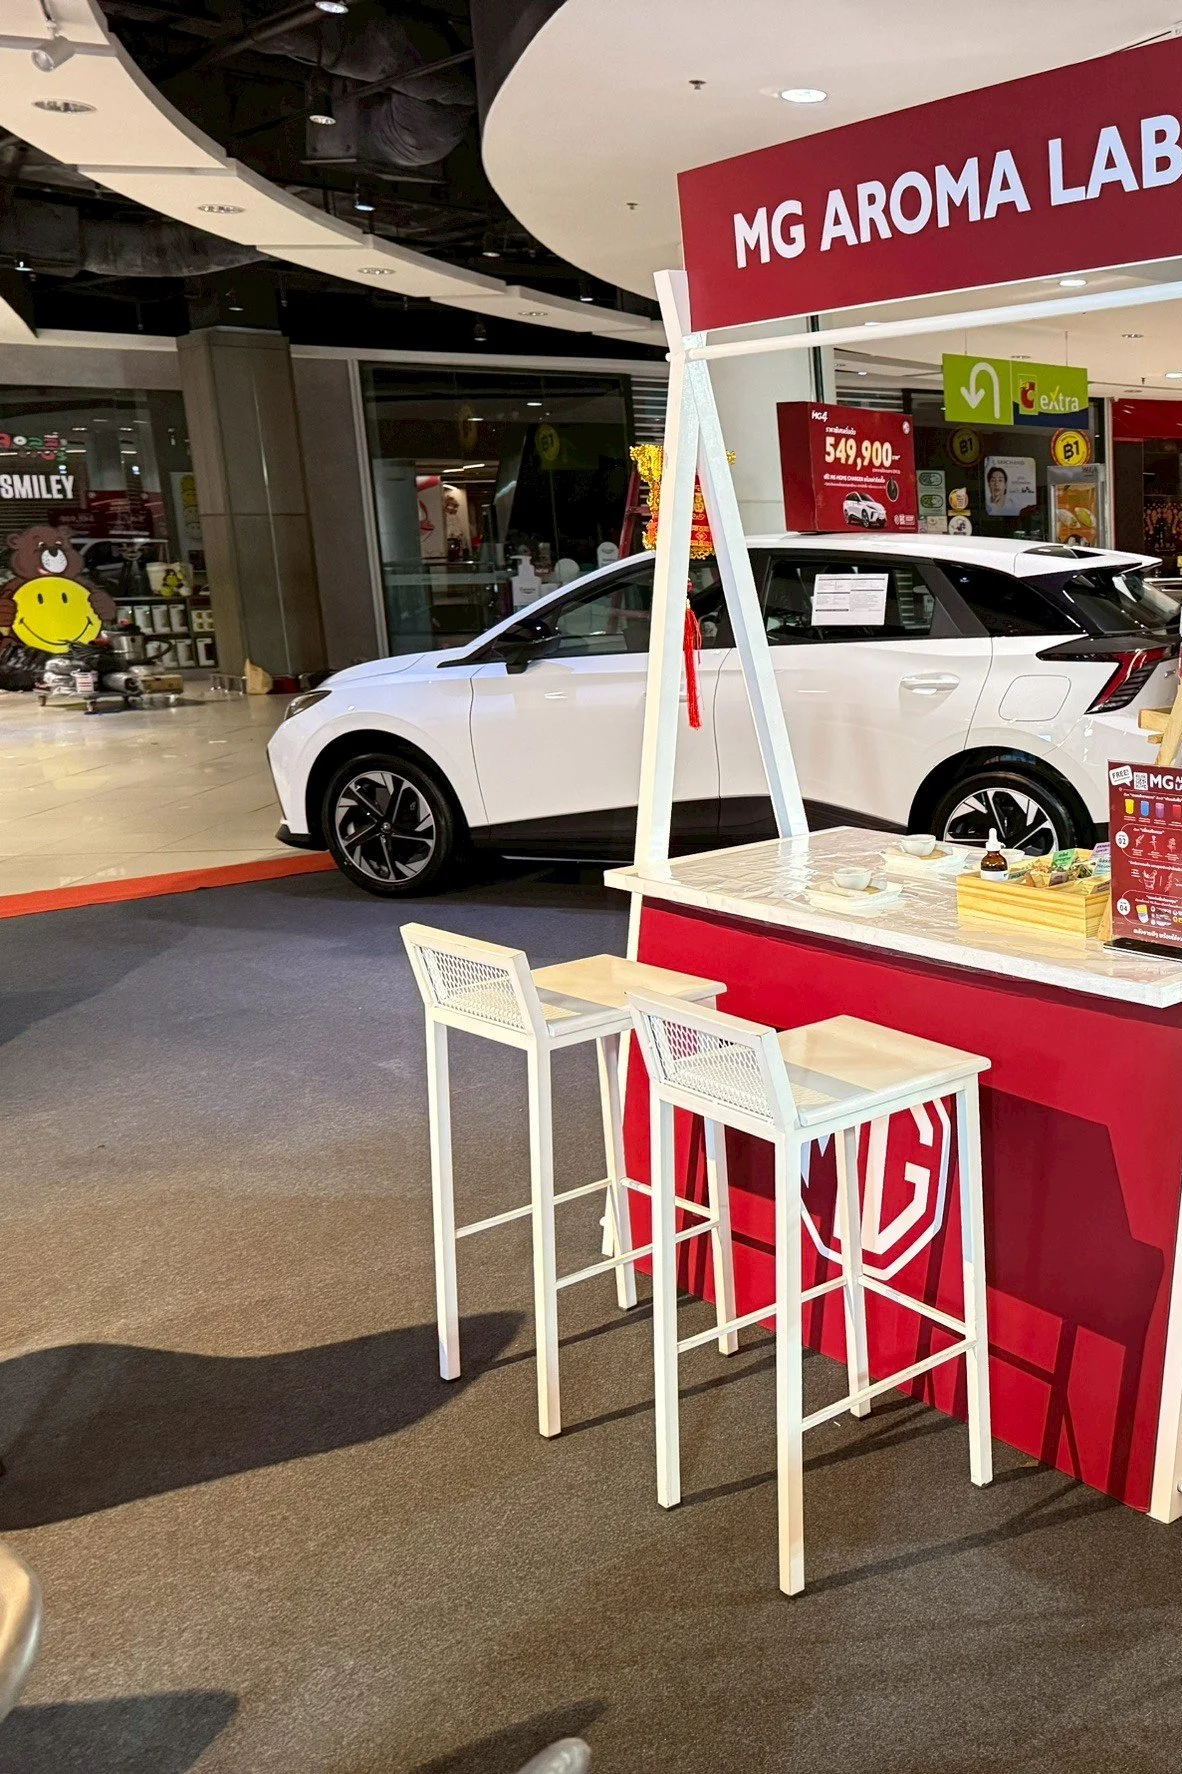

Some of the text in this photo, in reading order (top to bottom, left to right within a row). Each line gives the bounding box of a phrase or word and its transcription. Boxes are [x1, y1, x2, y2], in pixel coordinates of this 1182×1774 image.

[733, 199, 805, 268] MG
[820, 150, 1031, 252] AROMA
[824, 436, 893, 471] 549,900
[0, 474, 75, 499] SMILEY
[1111, 769, 1129, 779] FREE!
[1150, 774, 1174, 790] MG
